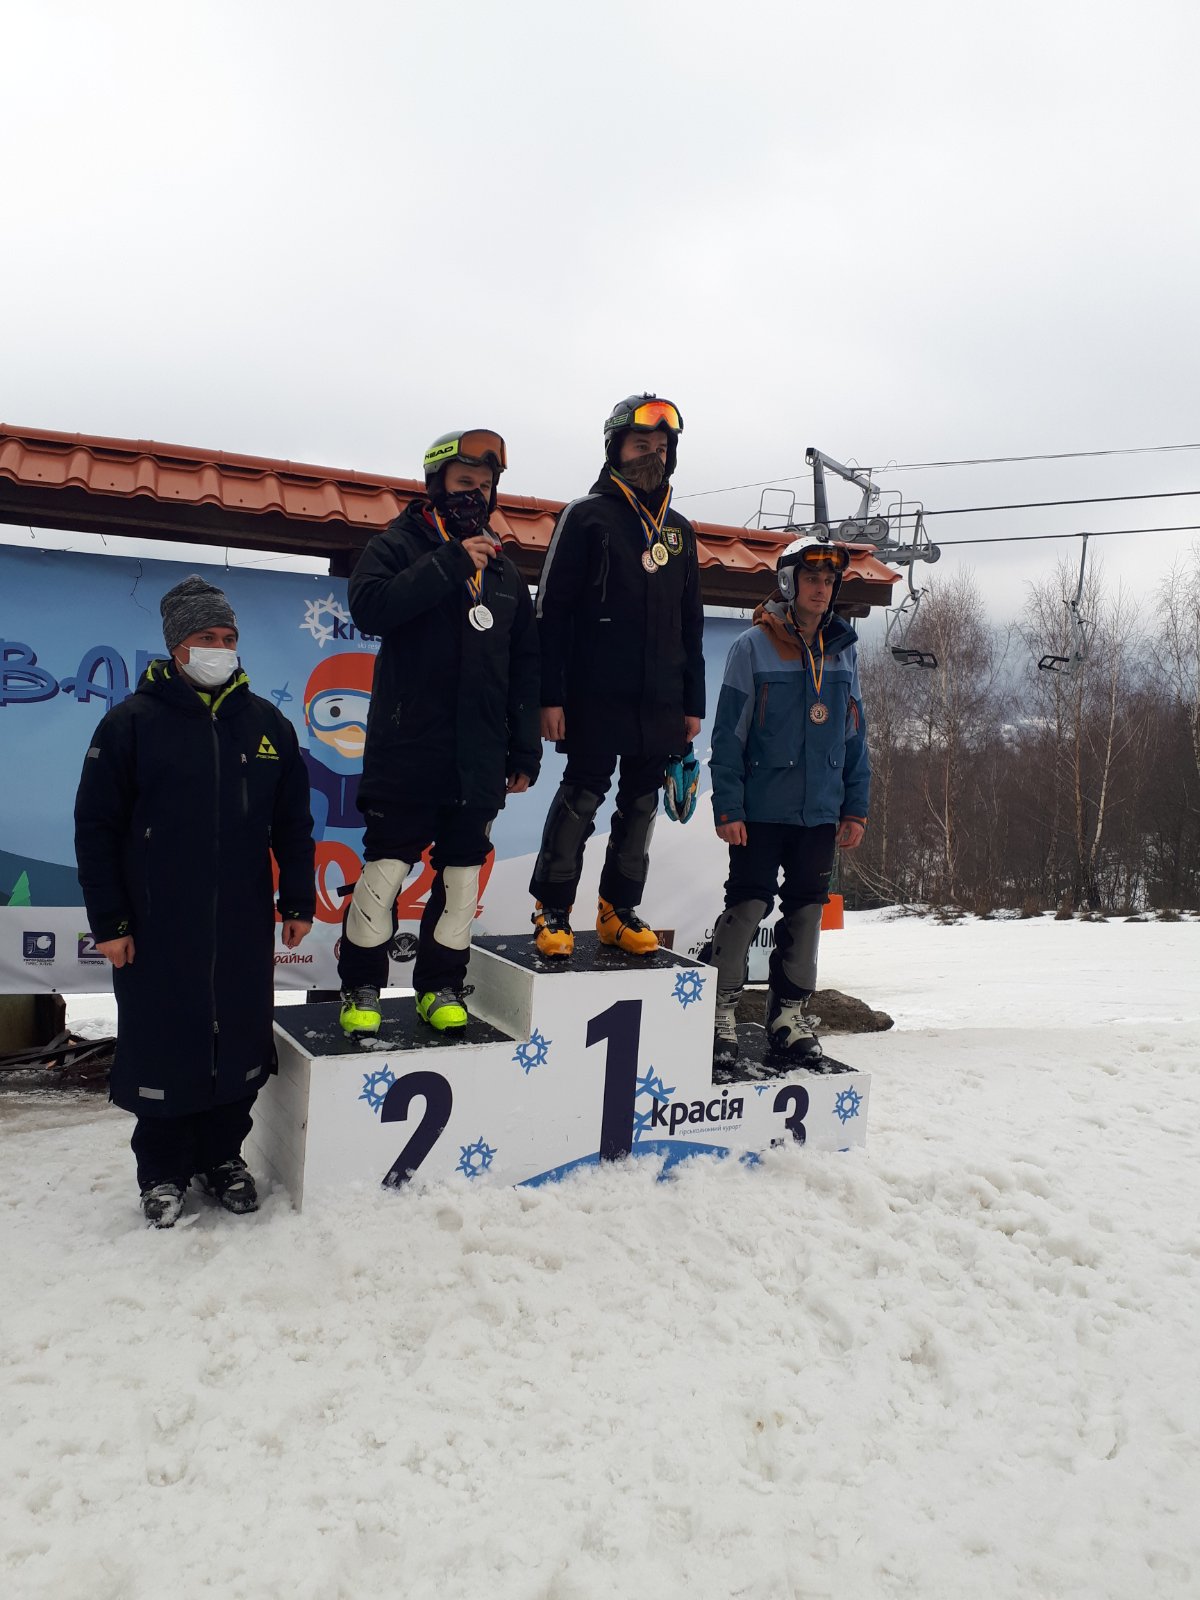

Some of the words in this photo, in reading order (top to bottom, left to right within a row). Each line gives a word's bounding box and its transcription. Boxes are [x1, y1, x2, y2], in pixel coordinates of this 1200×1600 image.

[425, 446, 454, 460] HEAD
[586, 999, 642, 1163] 1
[380, 1071, 453, 1191] 2
[651, 1090, 744, 1136] красія
[770, 1084, 810, 1147] 3
